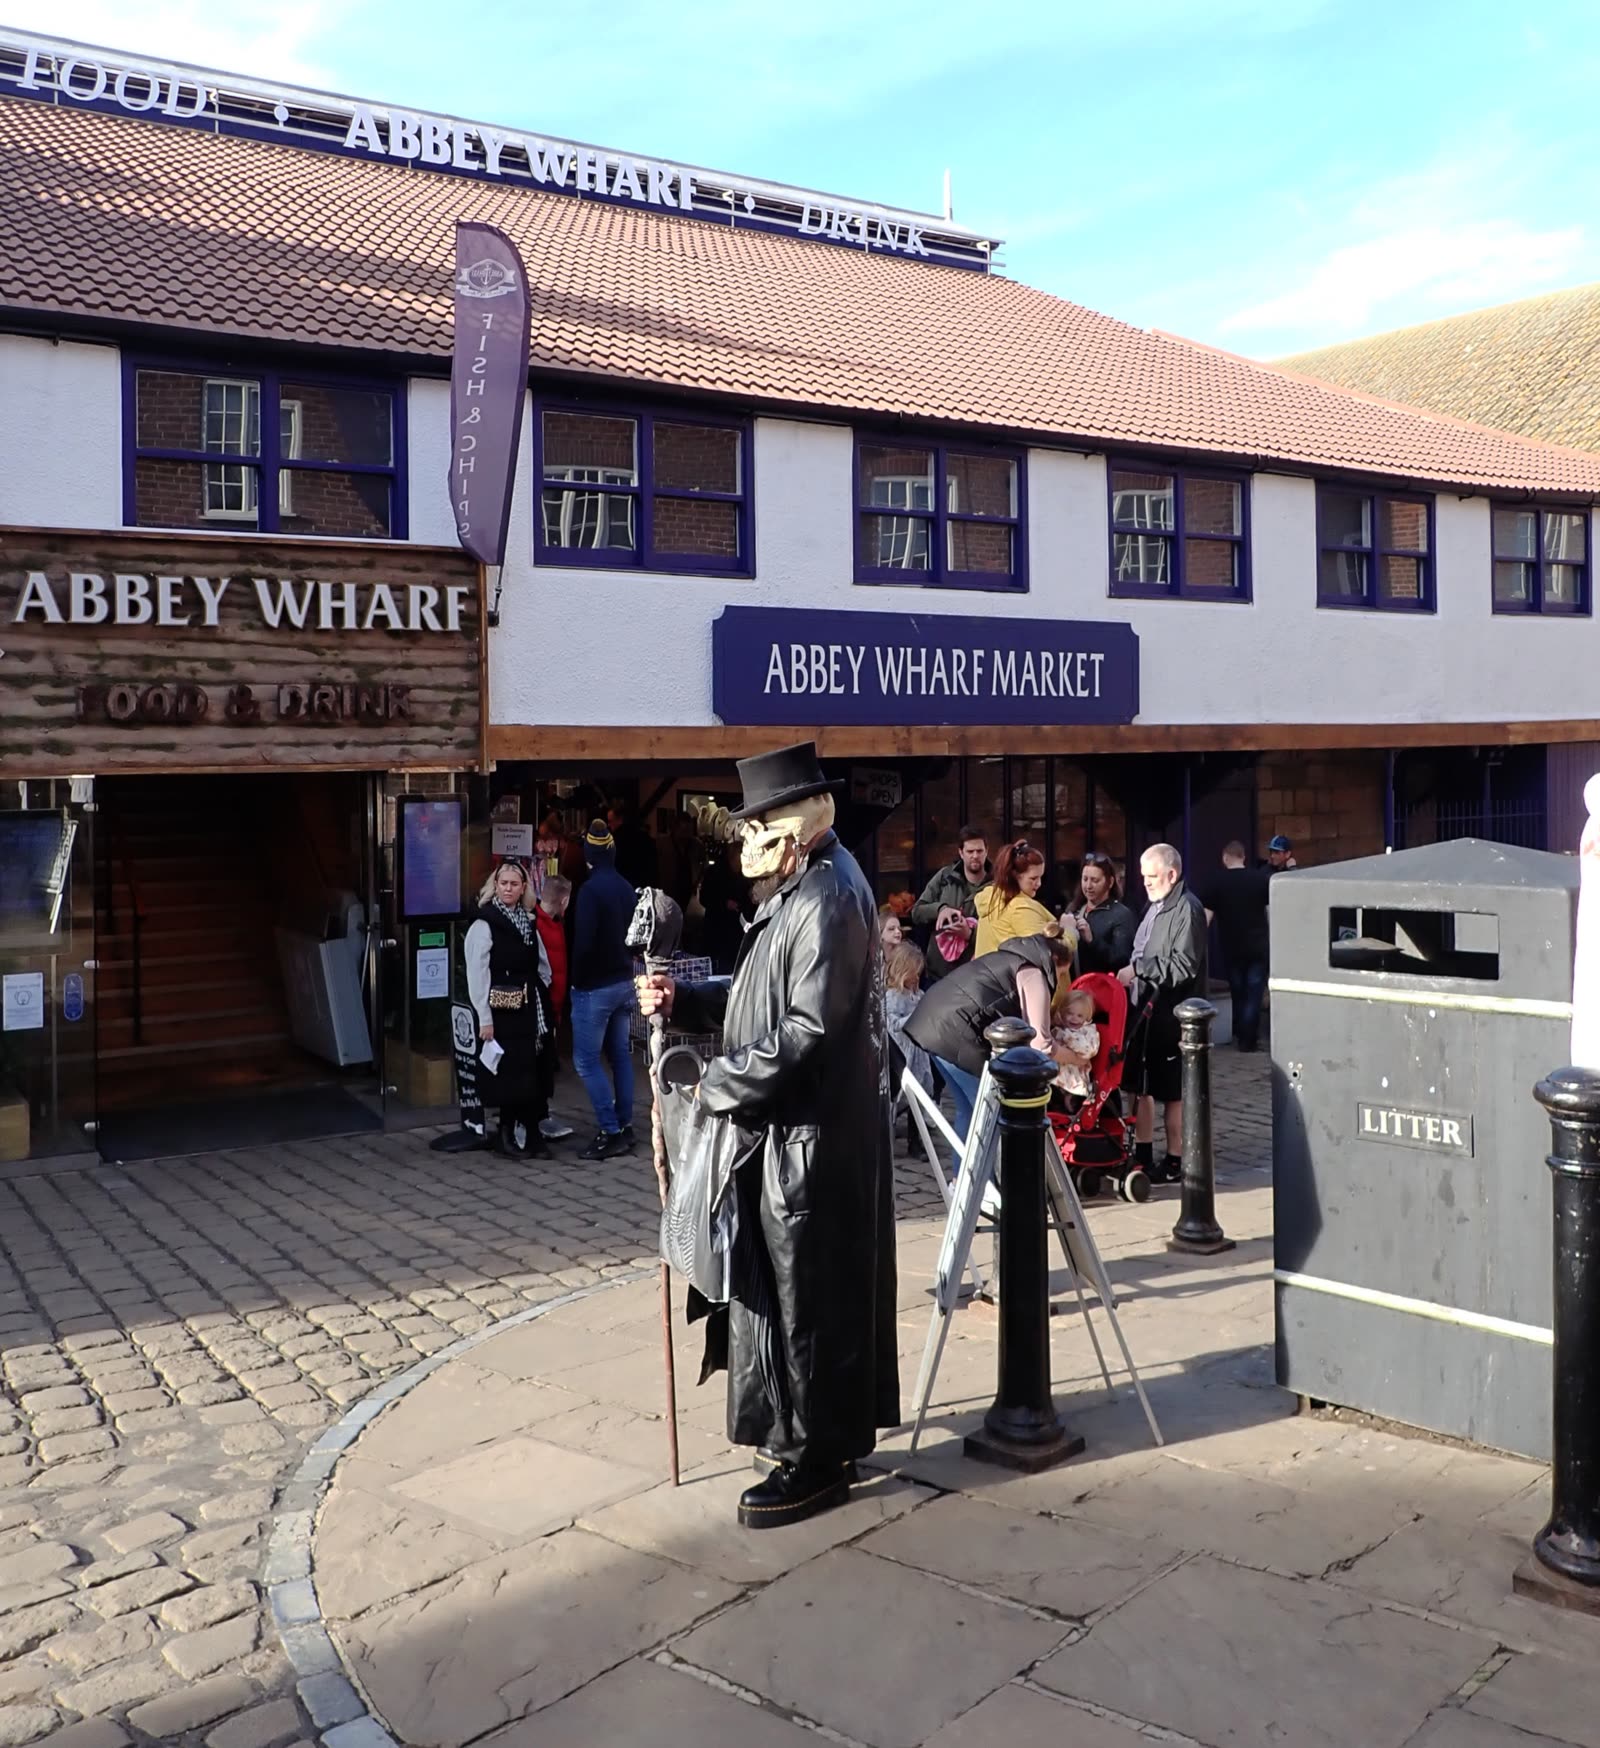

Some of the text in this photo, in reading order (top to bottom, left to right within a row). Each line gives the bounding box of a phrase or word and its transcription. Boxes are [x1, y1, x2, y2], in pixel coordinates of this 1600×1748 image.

[16, 48, 207, 118] FOOD
[343, 104, 698, 210] ABBEY WHARF
[798, 201, 929, 256] DRINK
[12, 571, 469, 632] ABBEY WHARF
[763, 643, 1105, 698] ABBEY WHARF MARKET
[277, 683, 415, 723] DRINK
[1363, 1107, 1463, 1146] LITTER
